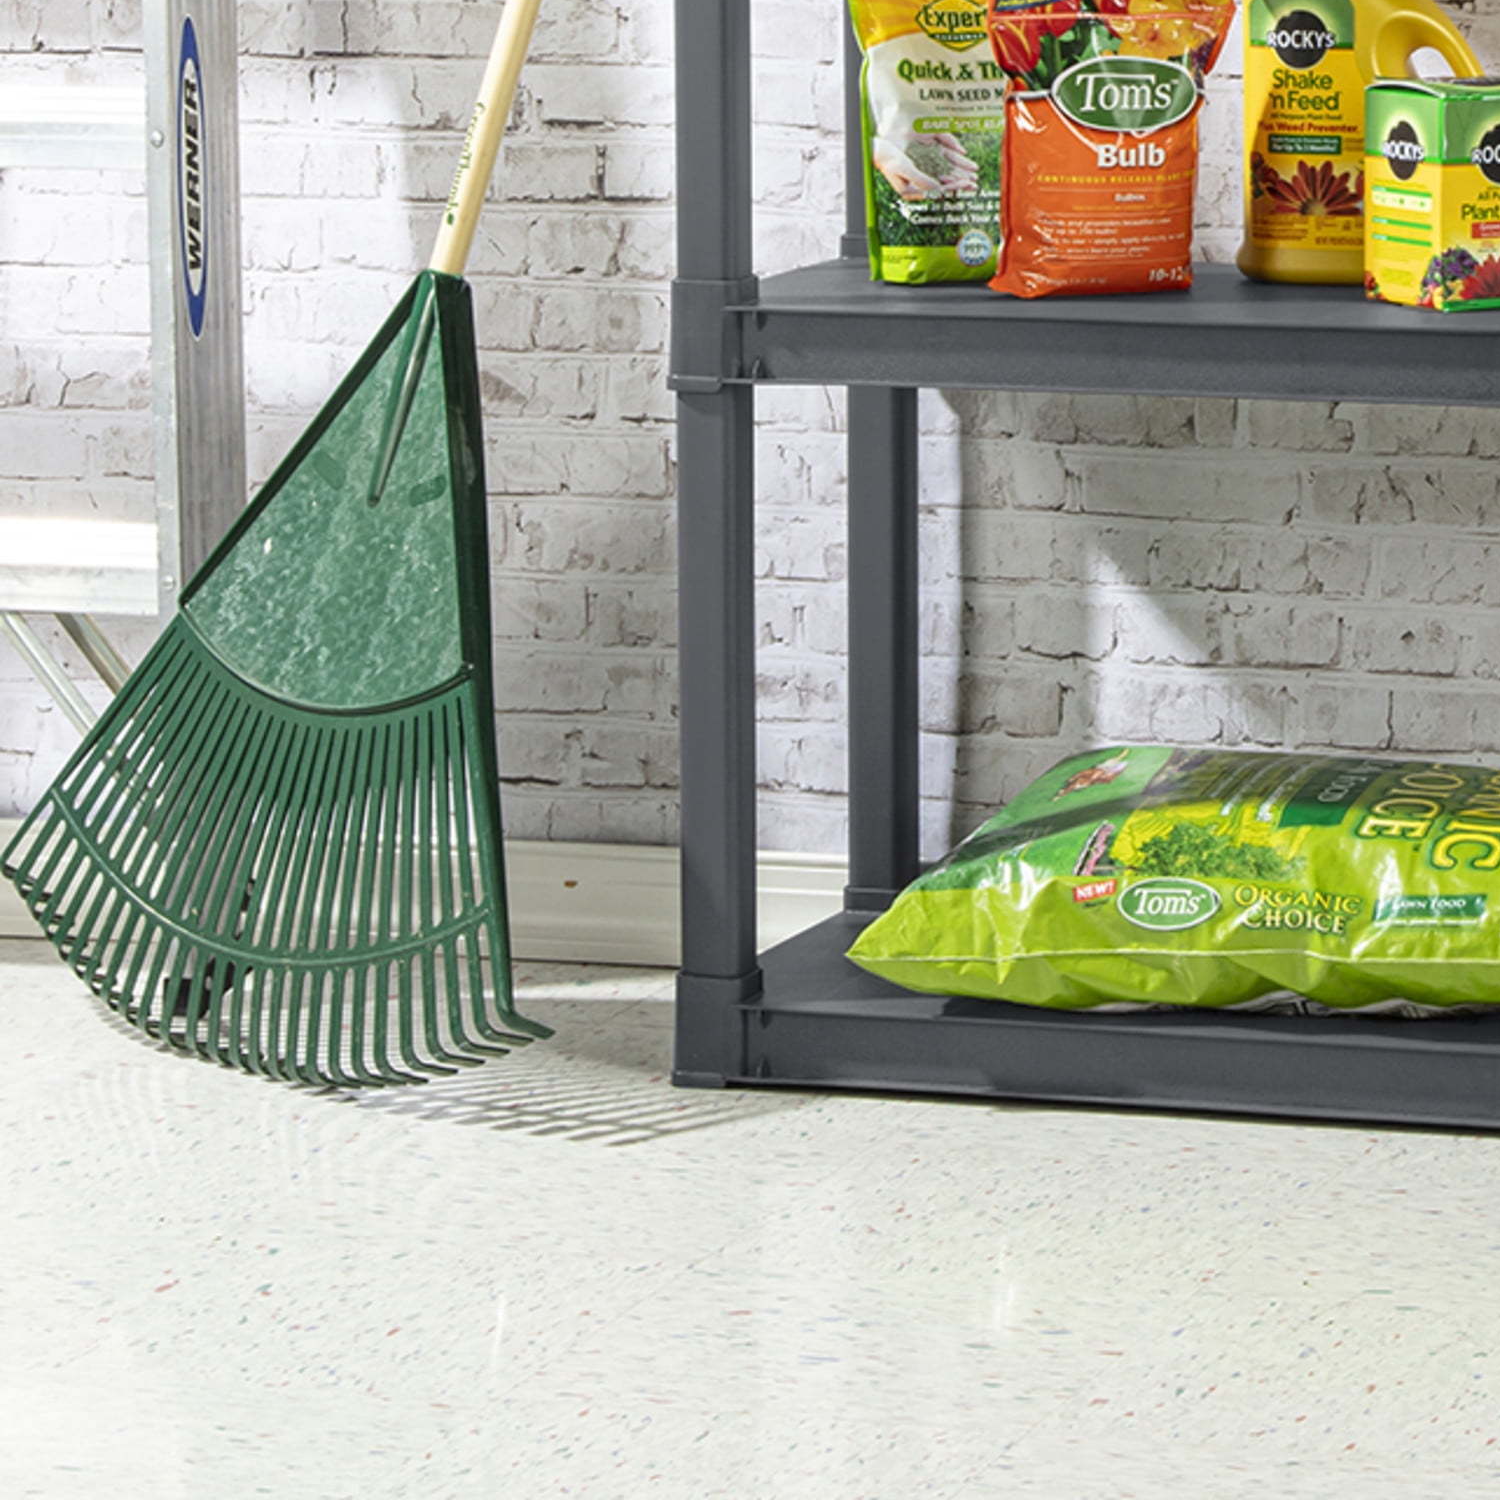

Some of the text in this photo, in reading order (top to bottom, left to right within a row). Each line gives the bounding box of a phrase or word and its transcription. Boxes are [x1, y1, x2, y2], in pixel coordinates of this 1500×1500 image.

[1267, 29, 1335, 49] ROCKYS
[897, 57, 1004, 84] Quick & Th
[1272, 68, 1333, 90] Shake
[957, 88, 992, 101] SEED
[1287, 90, 1340, 111] Feed
[1097, 143, 1166, 168] Bulb
[1382, 140, 1425, 162] ROCKYS
[184, 77, 202, 271] WERNER
[1461, 203, 1500, 220] Plant
[1359, 769, 1465, 838] OICE
[1234, 884, 1361, 915] ORGANIC
[1242, 903, 1346, 934] CHOICE
